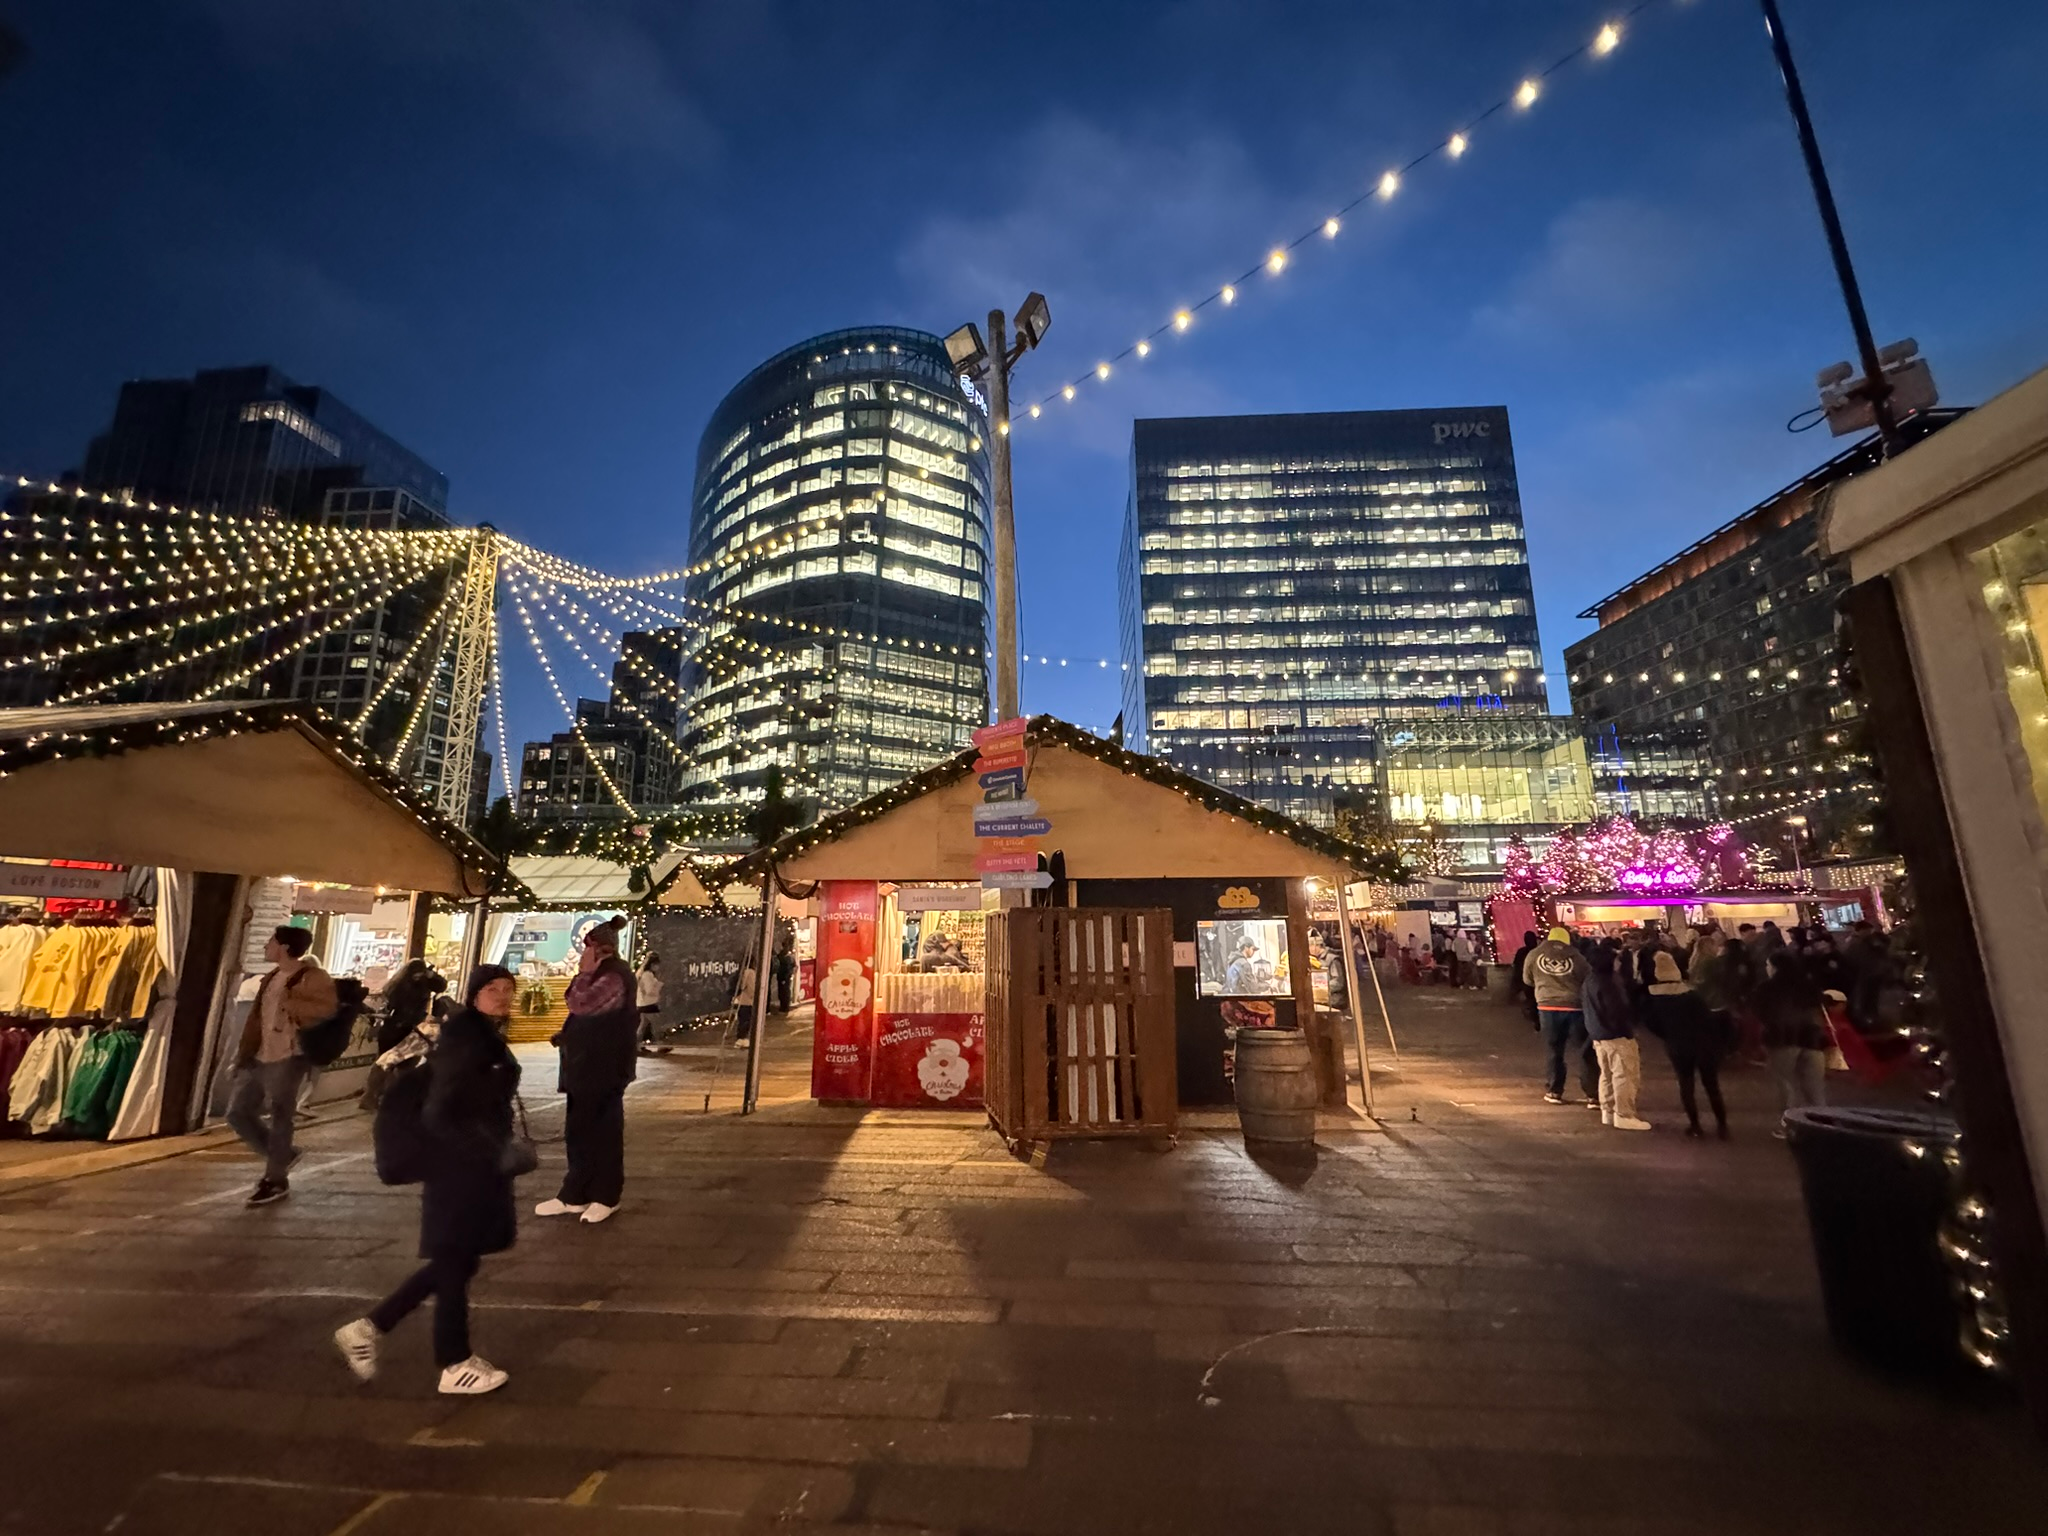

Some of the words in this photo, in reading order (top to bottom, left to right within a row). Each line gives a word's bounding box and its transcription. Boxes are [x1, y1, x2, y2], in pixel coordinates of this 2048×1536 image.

[1431, 421, 1490, 444] pwc
[979, 824, 991, 832] THE
[991, 823, 1019, 831] CURRENT
[1019, 822, 1045, 831] CHALETS
[1013, 857, 1027, 865] YETI
[11, 875, 46, 888] LOVE
[51, 876, 102, 889] BOSTON
[991, 873, 1018, 881] CURLING
[1019, 873, 1038, 881] LANES
[1622, 870, 1661, 887] Betty's
[1663, 870, 1690, 884] Bar
[838, 902, 860, 910] HOT
[821, 911, 875, 922] CHOCOLATE
[689, 962, 699, 977] MY
[700, 961, 724, 978] WINTER
[725, 961, 739, 975] WISH
[893, 1017, 911, 1028] HOT
[879, 1026, 935, 1047] CHOCOLATE
[826, 1043, 859, 1053] APPLE
[824, 1053, 860, 1063] CIDER
